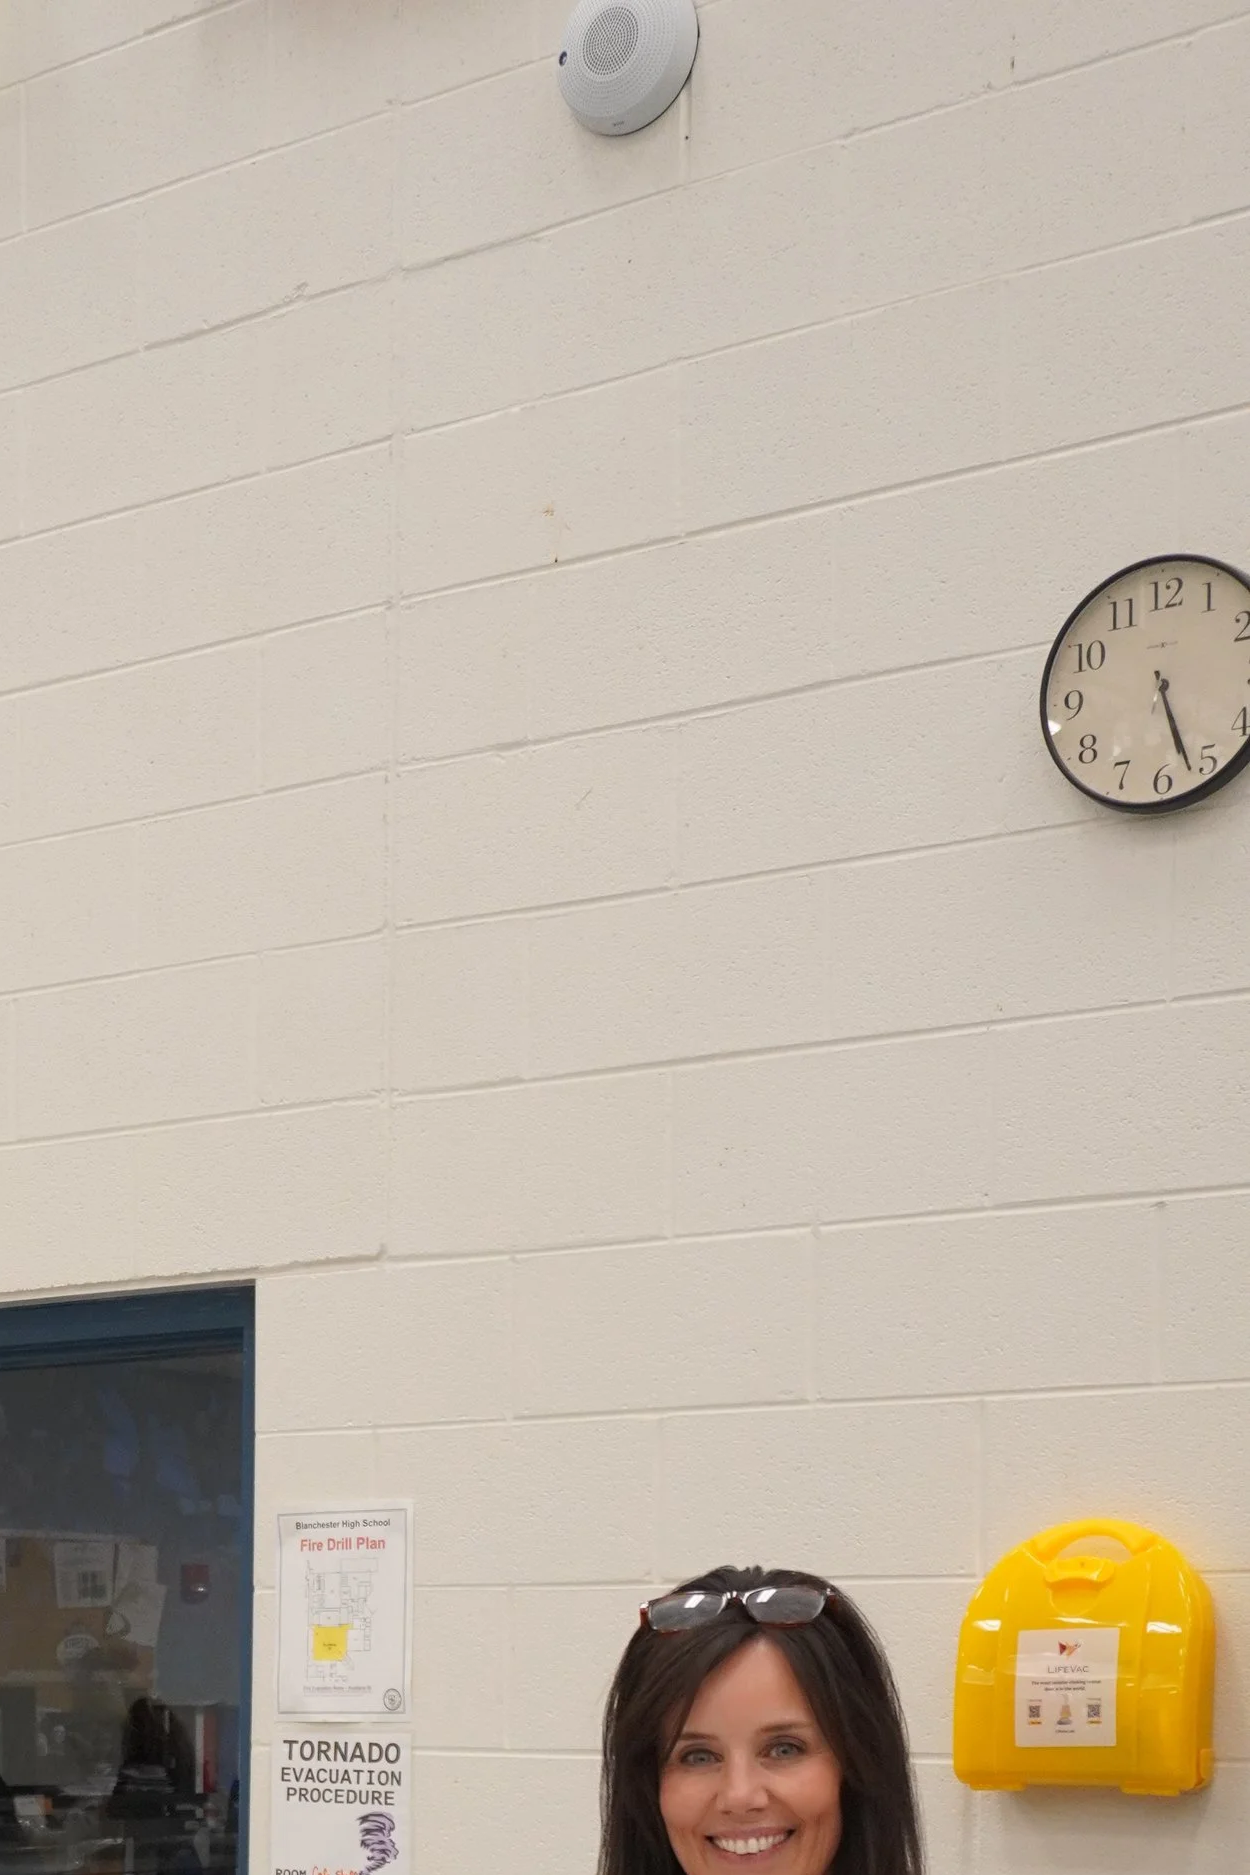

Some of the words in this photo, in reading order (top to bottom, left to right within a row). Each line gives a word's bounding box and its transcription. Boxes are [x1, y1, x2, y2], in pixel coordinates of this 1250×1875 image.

[1149, 577, 1183, 613] 12
[1201, 582, 1215, 613] 1
[1107, 598, 1137, 632] 11
[1073, 640, 1106, 673] 10
[1064, 690, 1084, 720] 9
[1078, 734, 1098, 764] 8
[1199, 744, 1218, 775] 5
[1113, 760, 1131, 790] 7
[1153, 764, 1173, 794] 6
[295, 1520, 340, 1530] Blanchester
[341, 1520, 361, 1529] High
[362, 1519, 391, 1528] School
[300, 1538, 323, 1552] Fire
[327, 1537, 352, 1551] Drill
[356, 1536, 386, 1550] Plan
[283, 1739, 401, 1764] TORNADO
[281, 1767, 402, 1787] EVACUATION
[286, 1787, 395, 1806] PROCEDURE
